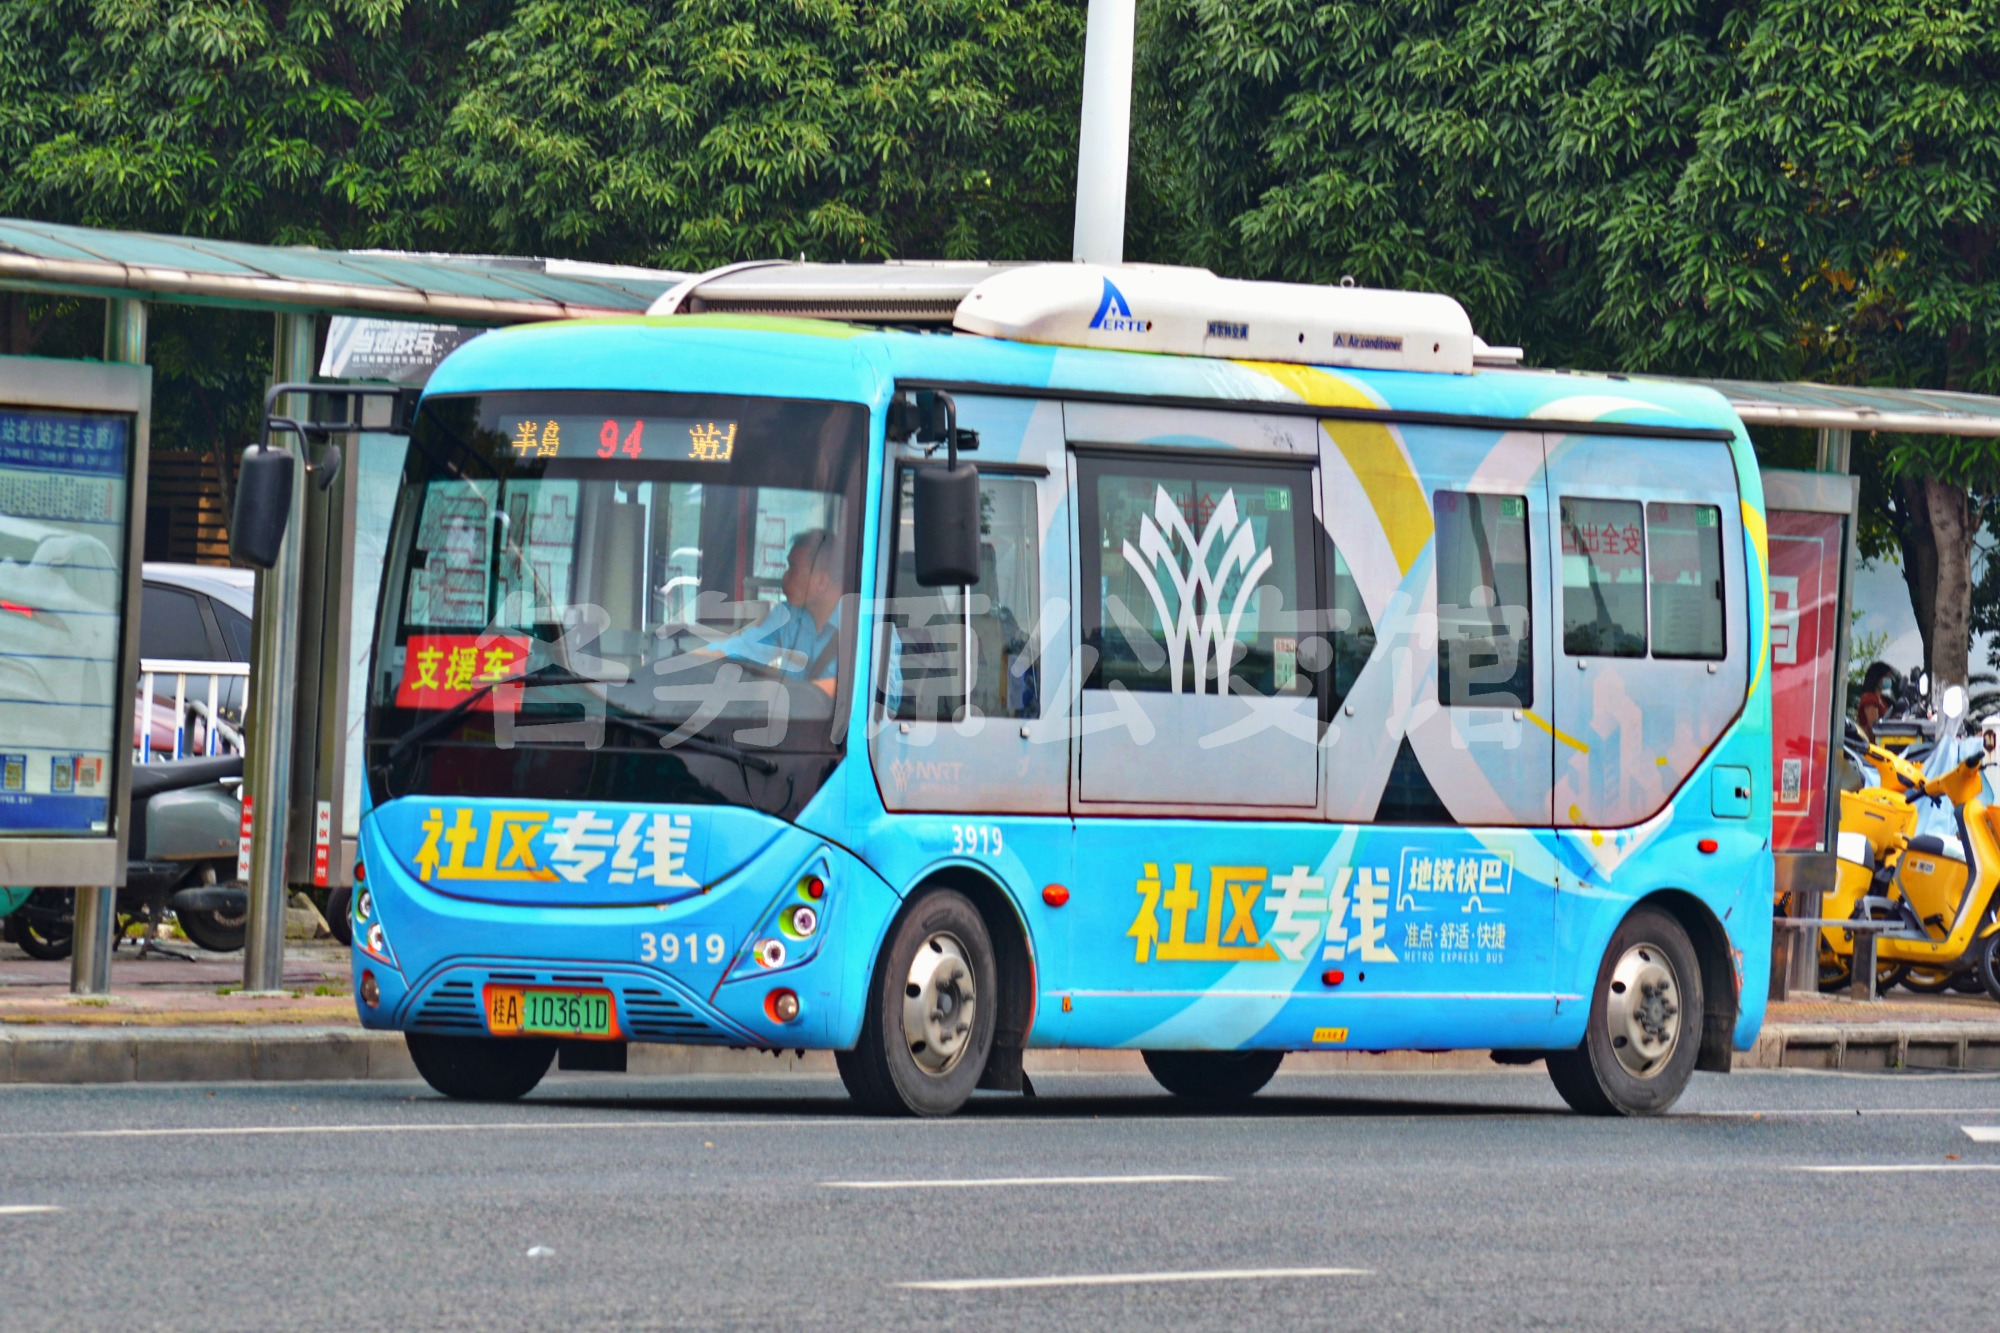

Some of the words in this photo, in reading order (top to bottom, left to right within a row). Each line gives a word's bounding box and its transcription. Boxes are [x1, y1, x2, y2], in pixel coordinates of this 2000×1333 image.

[1348, 334, 1359, 347] Air
[1361, 336, 1402, 351] conditioner
[512, 420, 559, 457] 半岛
[597, 419, 644, 459] 94
[411, 645, 514, 692] 支援车
[413, 808, 701, 888] 社区专线
[952, 823, 1003, 856] 3919
[1408, 857, 1505, 894] 地铁快巴
[1126, 862, 1399, 963] 社区专线
[640, 931, 725, 963] 3919
[1404, 952, 1434, 963] METRO
[1441, 952, 1479, 963] EXPRESS
[1486, 952, 1503, 963] BUS
